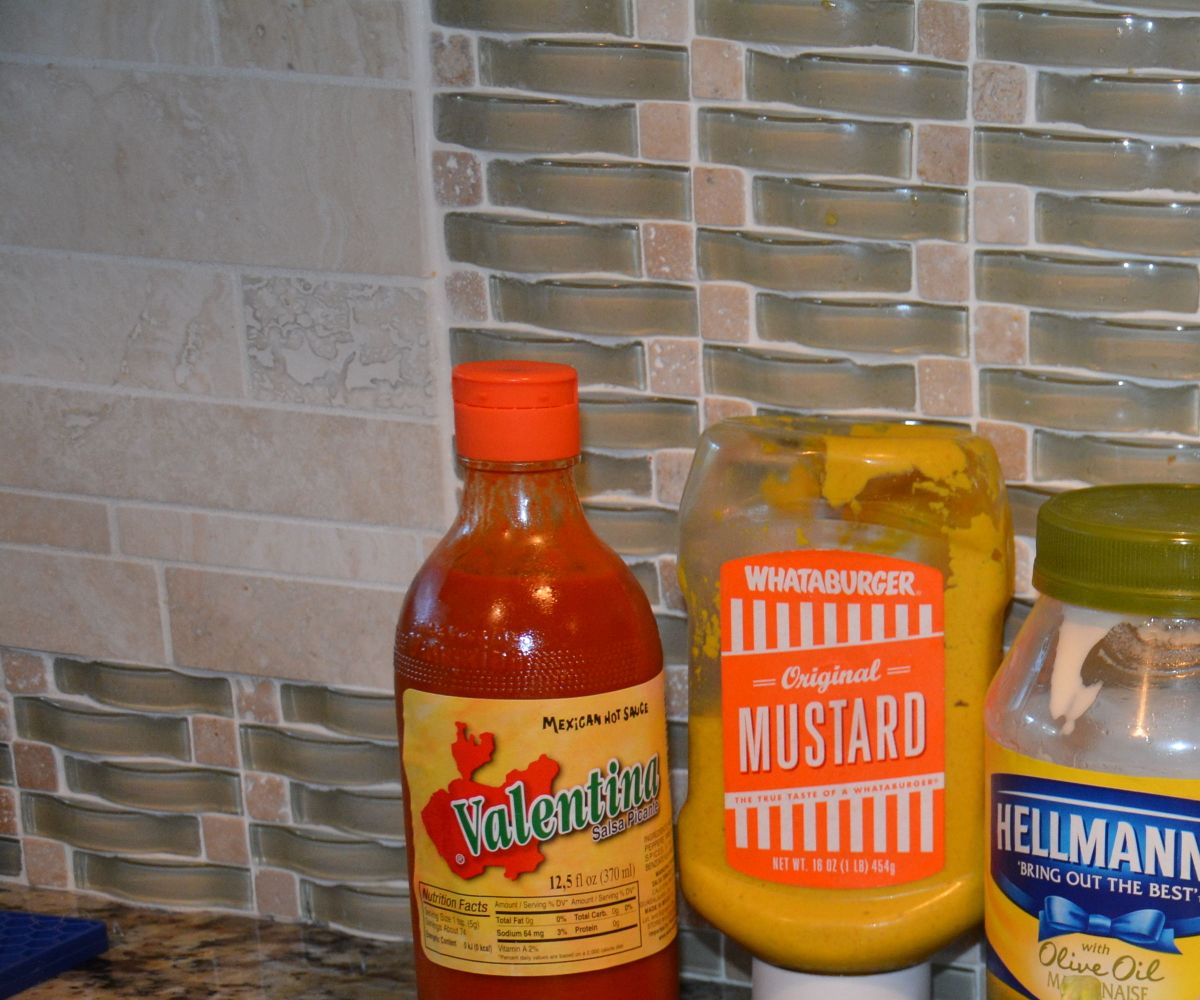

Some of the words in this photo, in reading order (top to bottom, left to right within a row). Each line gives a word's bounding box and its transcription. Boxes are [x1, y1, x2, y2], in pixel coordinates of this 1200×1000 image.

[745, 565, 915, 596] WHATABURGER
[781, 658, 881, 693] Original
[604, 709, 621, 725] HOT
[623, 702, 649, 721] SAUCE
[738, 692, 926, 774] MUSTARD
[451, 752, 660, 857] Valentina
[735, 796, 752, 804] THE
[757, 795, 783, 803] TRUE
[787, 792, 817, 800] TASTE
[591, 819, 625, 843] Salsa
[772, 857, 789, 871] NET
[792, 857, 808, 872] WT.
[826, 859, 837, 872] OZ
[872, 859, 896, 876] 454g
[549, 874, 573, 892] 12,5
[586, 875, 597, 886] oz
[1066, 870, 1103, 890] OUT
[1107, 876, 1143, 896] THE
[422, 887, 457, 909] Nutrition
[460, 899, 488, 913] Facts
[575, 912, 590, 920] Total
[575, 925, 598, 934] Protein
[498, 944, 520, 953] Vitamin
[1081, 942, 1110, 955] with
[1038, 940, 1110, 977] Olive
[1112, 954, 1165, 982] Oil
